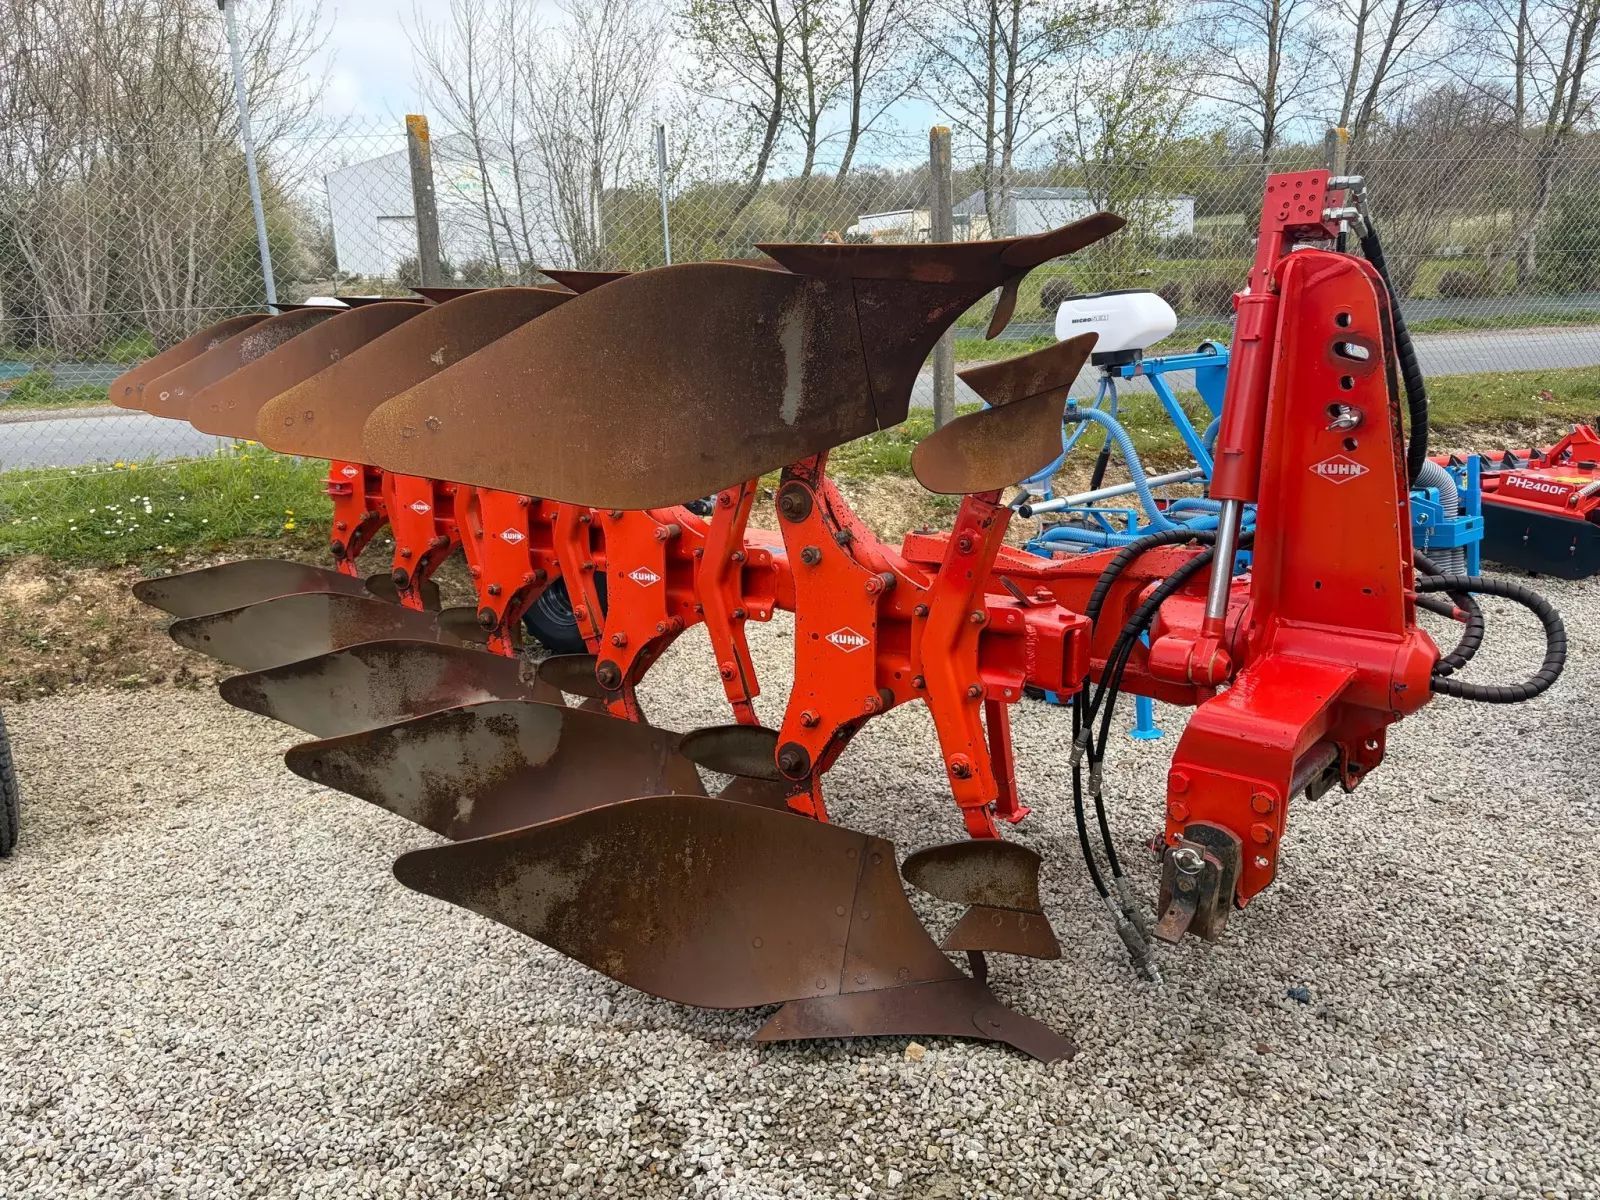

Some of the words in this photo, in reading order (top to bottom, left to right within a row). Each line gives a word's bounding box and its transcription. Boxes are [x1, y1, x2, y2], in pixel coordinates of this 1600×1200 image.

[1317, 463, 1361, 475] KUHN
[1506, 476, 1568, 495] PH2400F
[503, 531, 522, 540] KUHN
[632, 572, 657, 582] KUHN
[830, 633, 864, 646] KUHN
